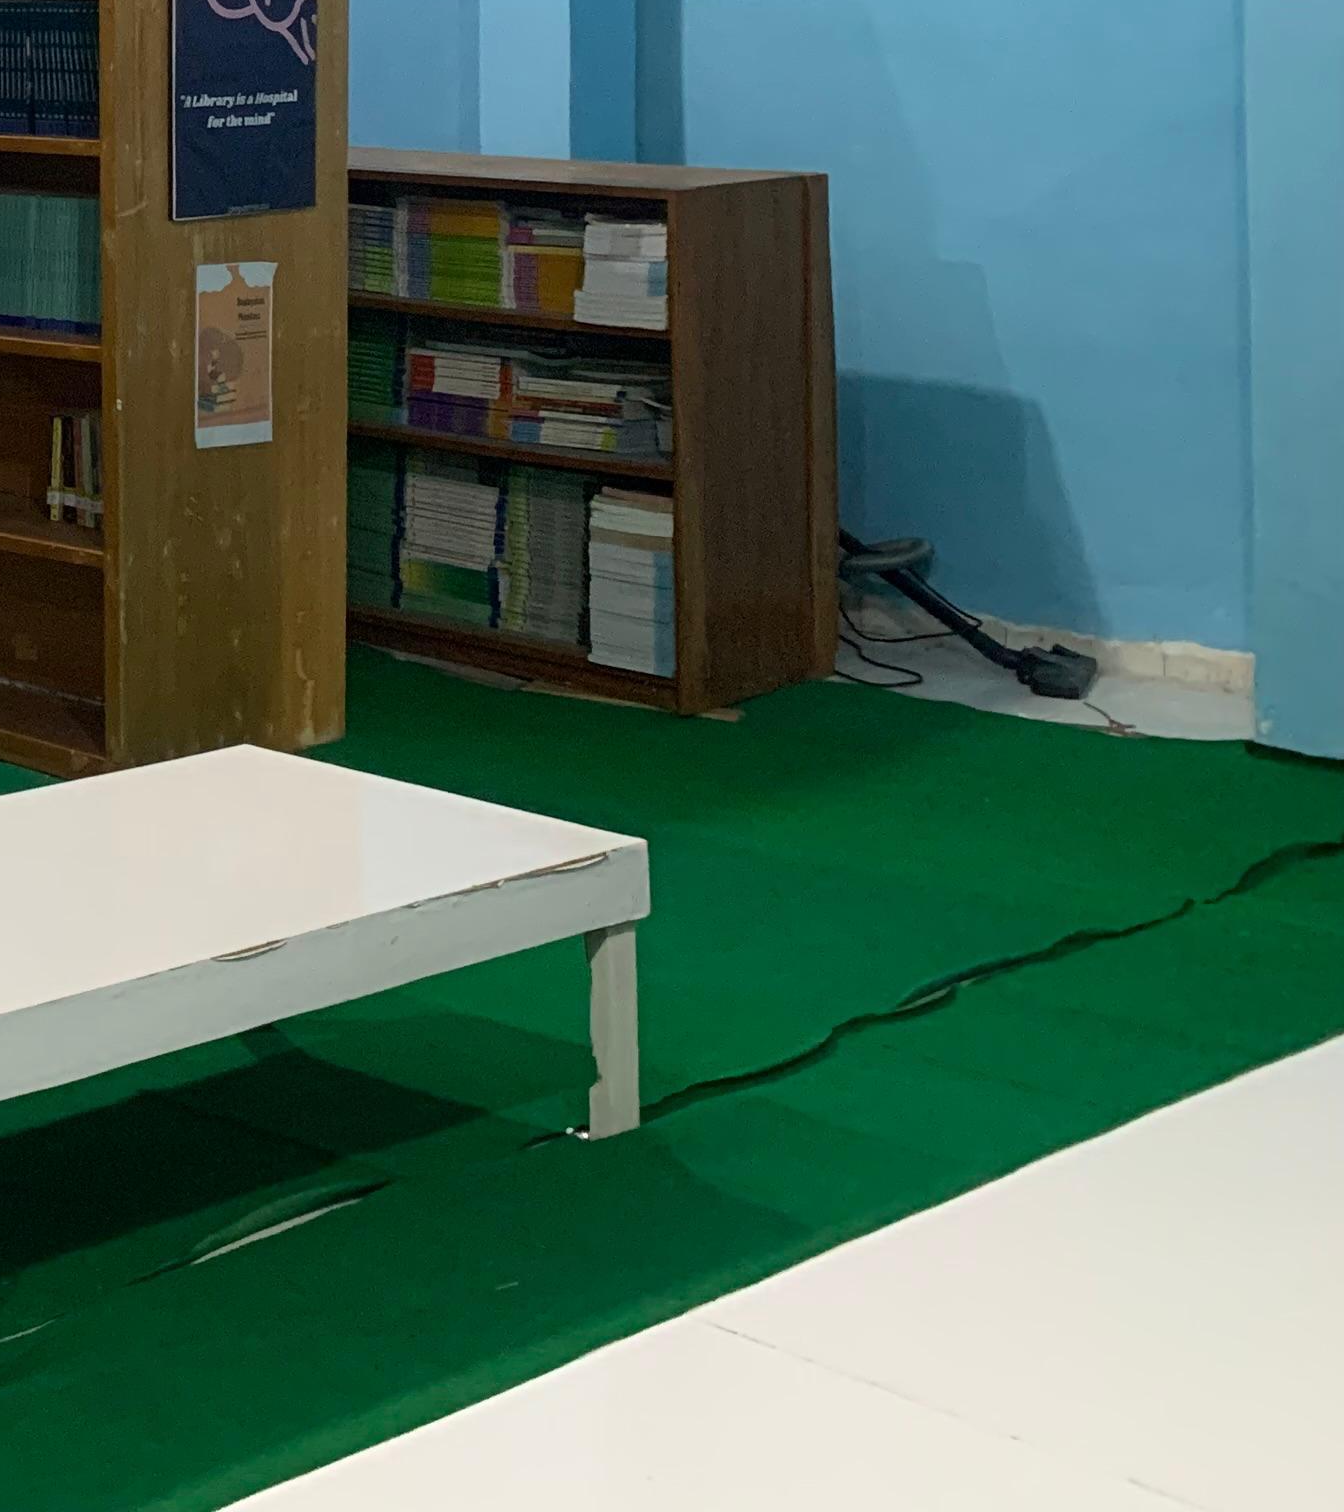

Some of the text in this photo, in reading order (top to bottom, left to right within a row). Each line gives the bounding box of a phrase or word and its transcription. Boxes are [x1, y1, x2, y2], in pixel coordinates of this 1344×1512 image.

[192, 93, 235, 108] Library
[235, 92, 246, 105] is
[254, 89, 298, 106] Hospital
[207, 115, 225, 128] for
[226, 115, 243, 127] the
